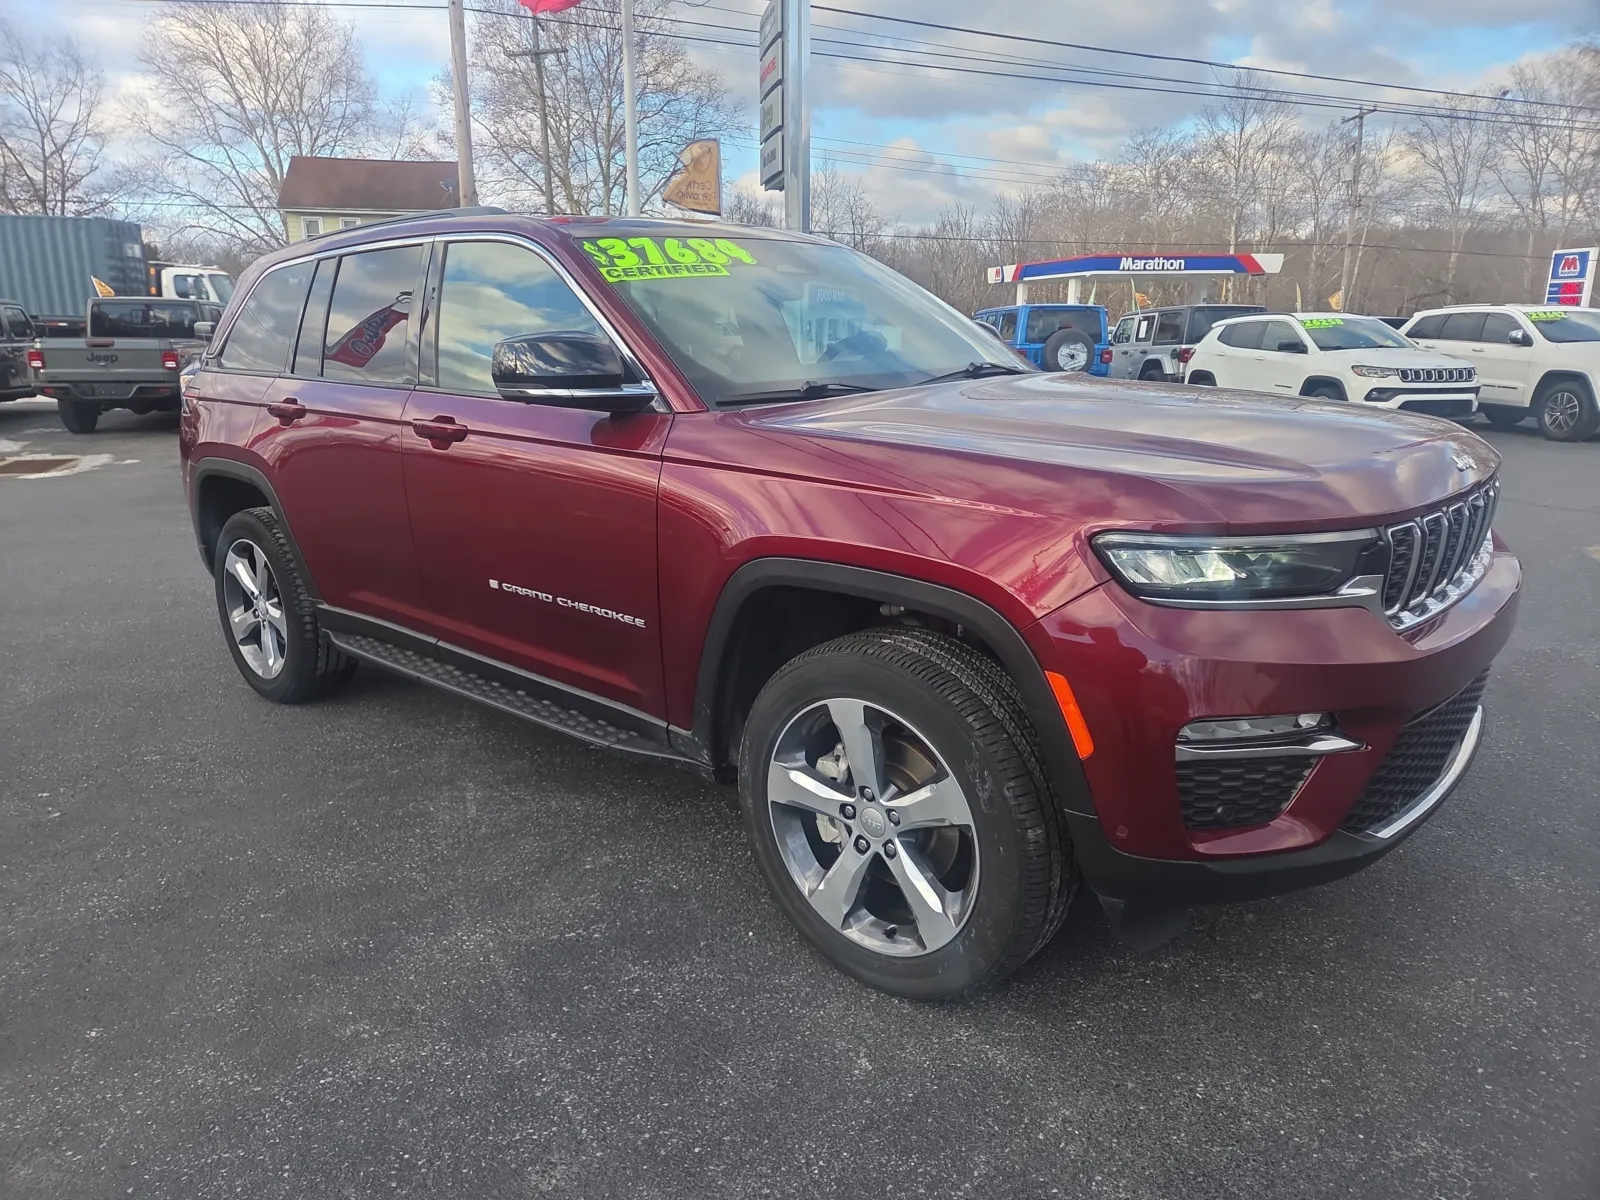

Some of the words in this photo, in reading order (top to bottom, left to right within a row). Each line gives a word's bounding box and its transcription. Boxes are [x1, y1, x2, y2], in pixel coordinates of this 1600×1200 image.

[583, 238, 758, 266] $37684
[605, 263, 722, 279] CERTIFIED
[1119, 257, 1185, 270] Marathon
[86, 352, 119, 364] Jeep
[502, 582, 553, 603] GRAND
[556, 596, 647, 629] CHEROKEE
